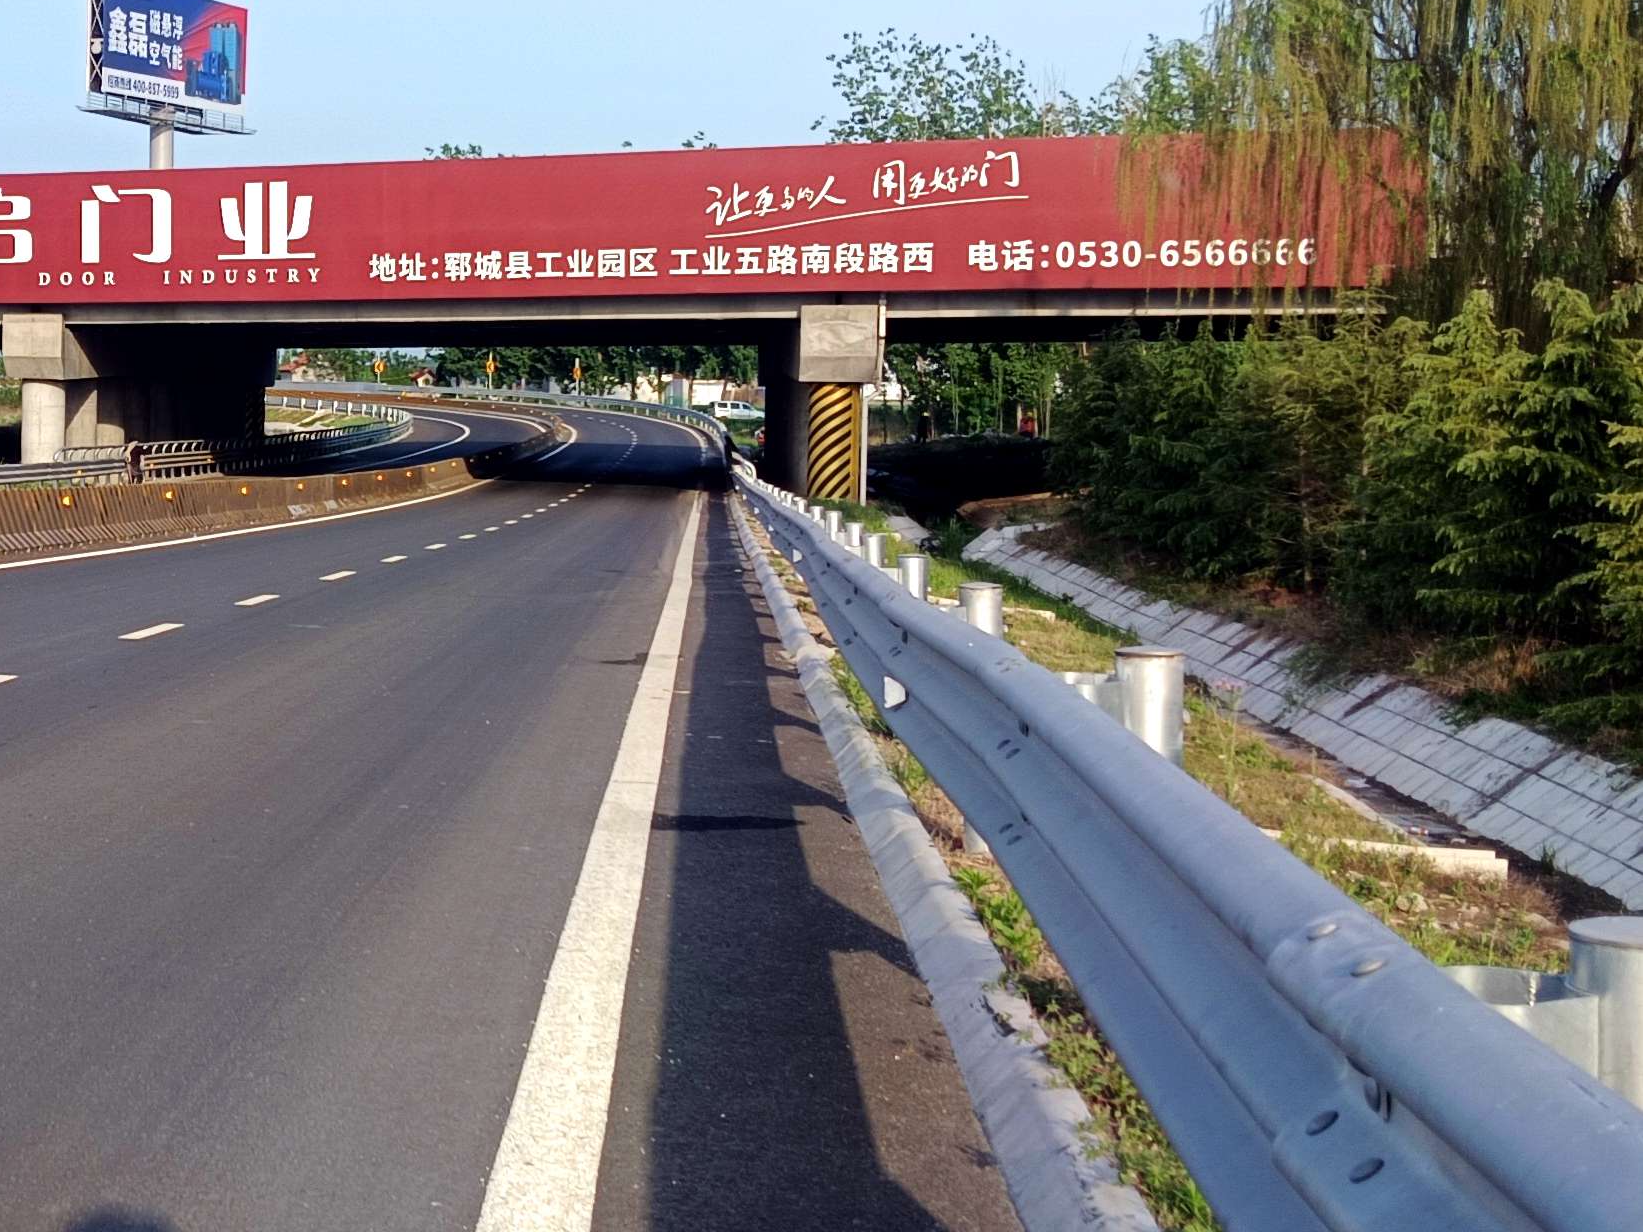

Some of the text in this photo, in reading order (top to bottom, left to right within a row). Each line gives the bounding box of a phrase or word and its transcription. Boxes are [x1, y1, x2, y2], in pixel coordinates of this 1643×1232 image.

[149, 40, 183, 71] 空气能
[872, 150, 1020, 205] 用更好的门
[38, 271, 116, 286] DOOR
[163, 267, 321, 285] INDUSTRY
[368, 247, 659, 282] 地址:郓城县工业园区
[668, 241, 934, 275] 工业五路南段路西
